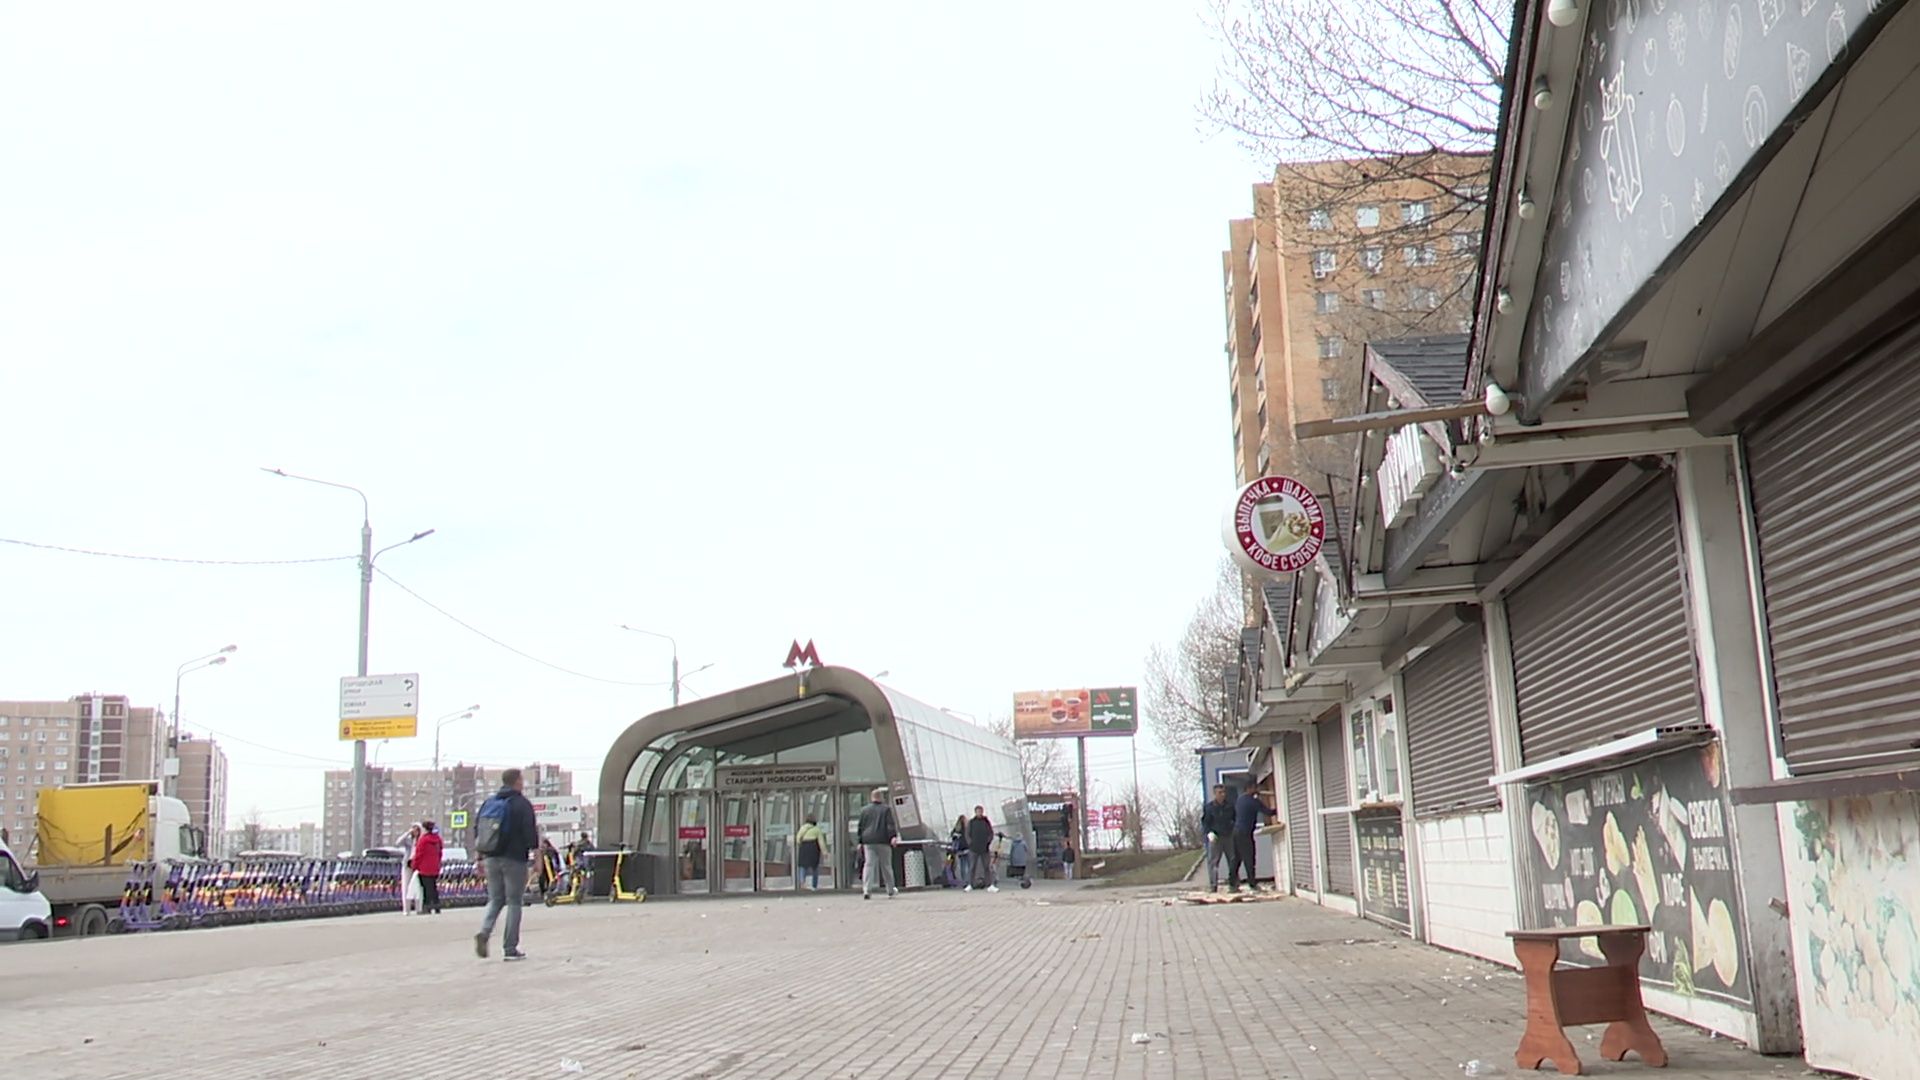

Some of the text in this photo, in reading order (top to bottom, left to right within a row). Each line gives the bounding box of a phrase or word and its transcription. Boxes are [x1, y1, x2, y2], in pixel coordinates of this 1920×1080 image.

[1237, 480, 1271, 533] ВЫПЕЧКА
[1282, 479, 1322, 524] ШАУРМА
[1246, 535, 1321, 570] КОФЕ С СОБОЙ
[725, 774, 826, 785] СТАНЦИЯ НОВОКОСИНО
[1028, 801, 1064, 813] Маркет
[1692, 845, 1730, 871] ВЫПЕЧКА
[1661, 872, 1687, 907] КОФЕ
